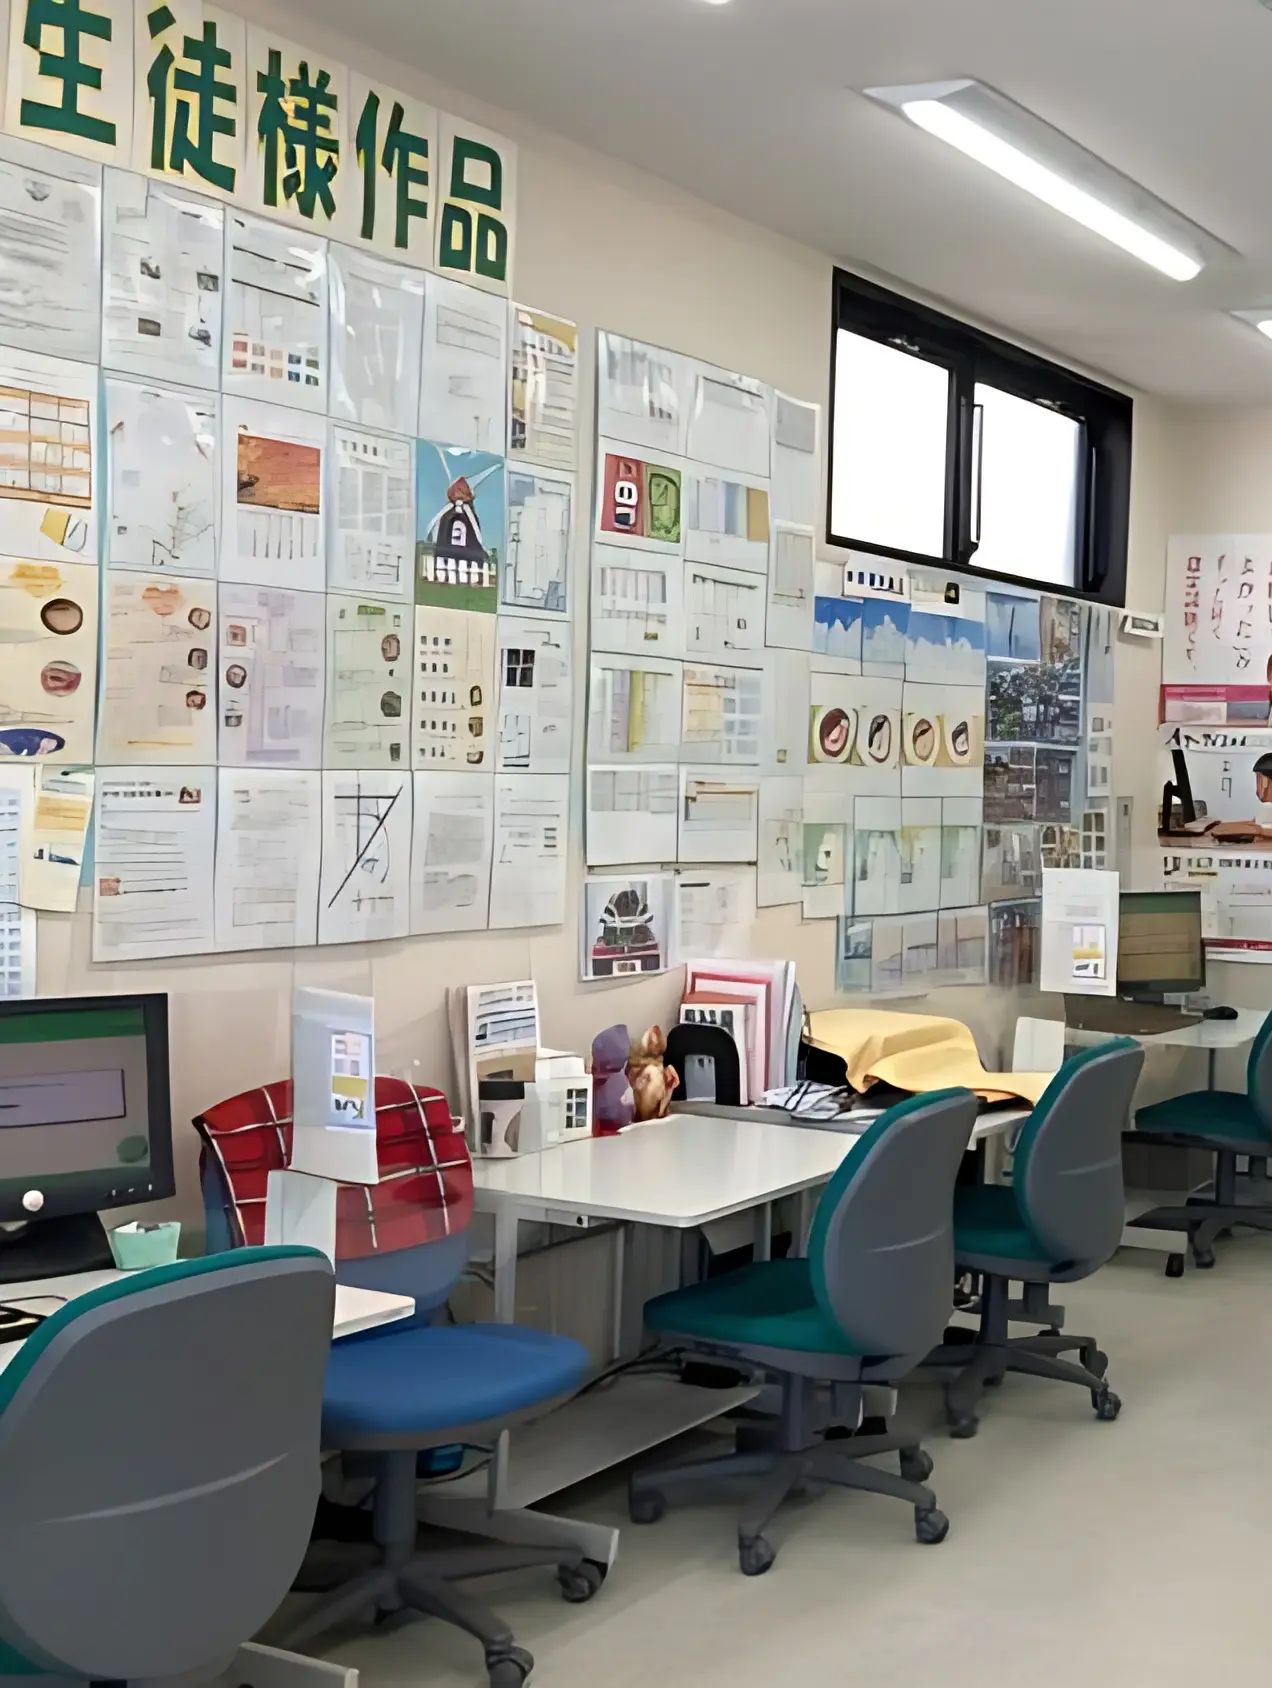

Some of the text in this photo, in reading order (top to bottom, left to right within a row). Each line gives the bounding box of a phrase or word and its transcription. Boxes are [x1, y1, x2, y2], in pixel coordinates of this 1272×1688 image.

[20, 0, 508, 281] 生徒様作品
